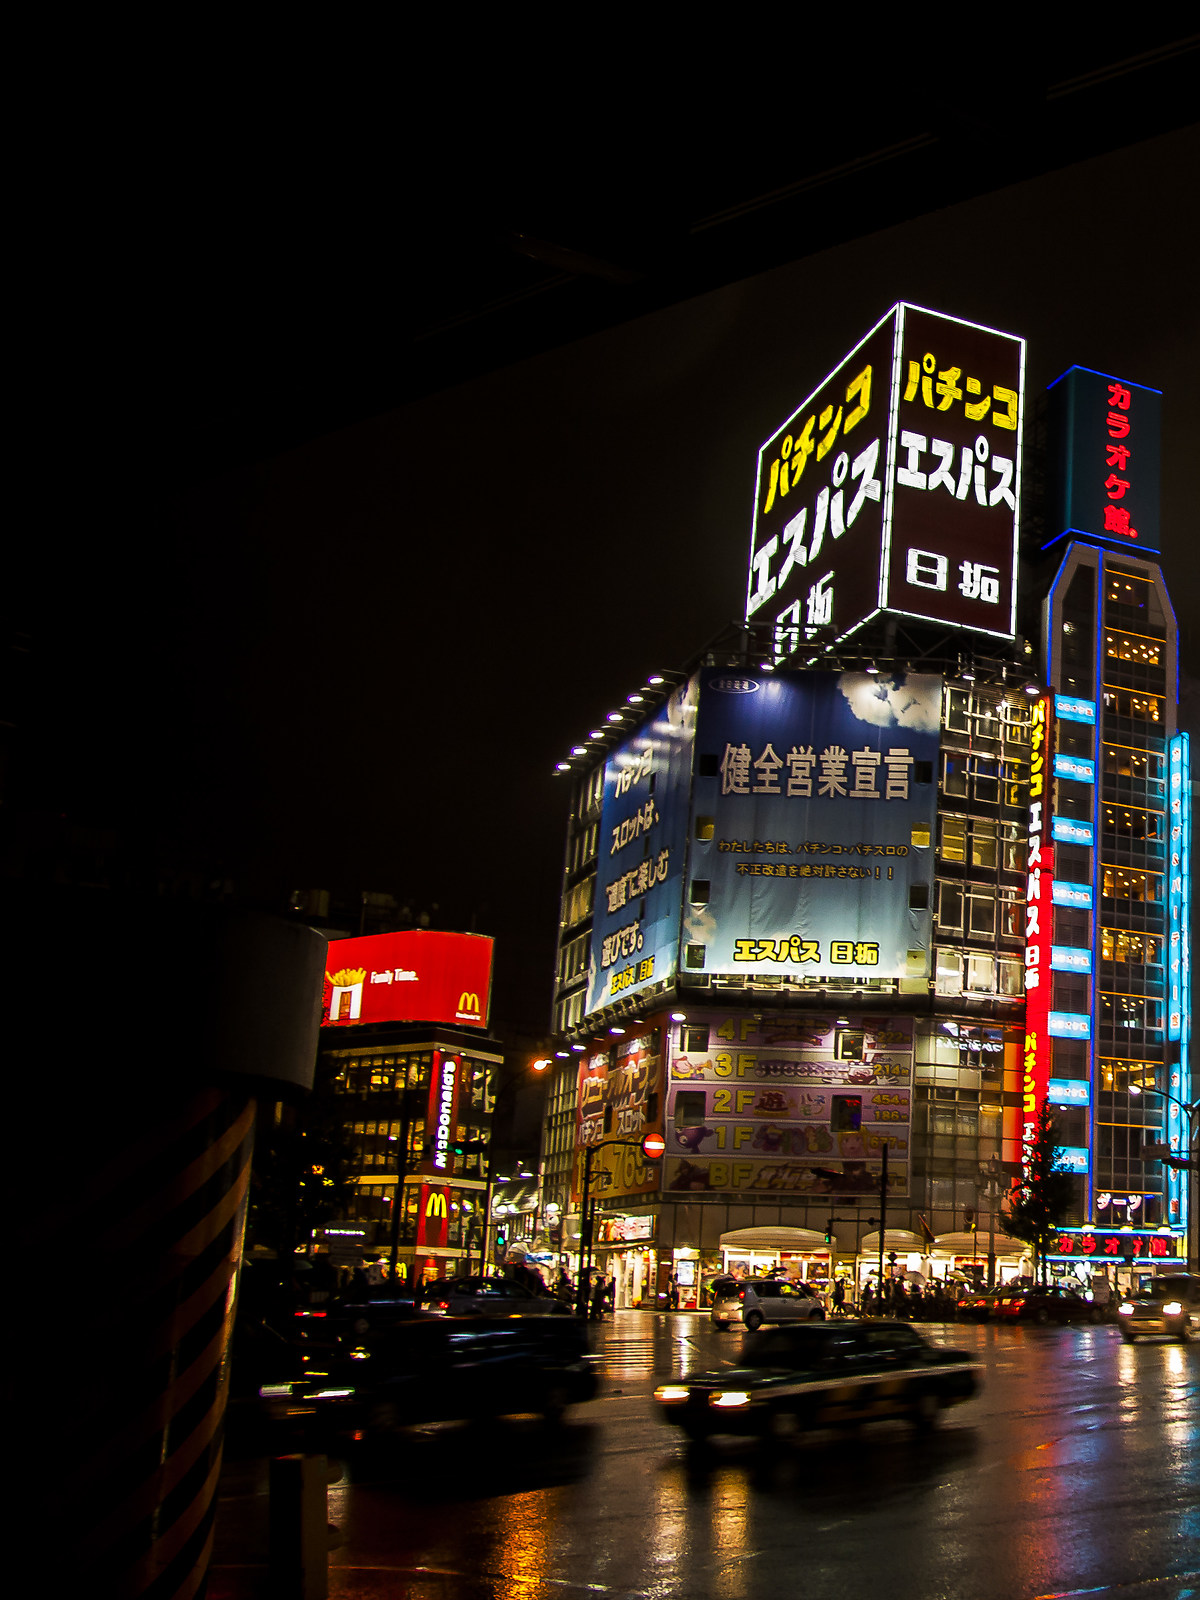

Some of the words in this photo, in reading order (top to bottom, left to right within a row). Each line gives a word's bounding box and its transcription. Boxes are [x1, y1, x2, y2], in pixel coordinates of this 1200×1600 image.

[903, 352, 1018, 431] パチンコ
[764, 365, 872, 514] パチンコ
[897, 430, 1016, 511] エスパス
[747, 438, 882, 616] エスパス
[1029, 699, 1046, 797] パチンコ
[720, 742, 915, 801] 健全営業宣言
[718, 840, 909, 858] わたしたちは、パチンコ・パチスロの
[606, 848, 670, 914] 適度に楽しむ
[737, 862, 894, 880] 不正改造を絶対許さない！！
[1027, 801, 1043, 938] エスパス
[733, 934, 821, 964] エスパス
[610, 963, 635, 996] エスパス
[717, 1018, 759, 1042] 4F
[714, 1053, 758, 1077] 3F
[1022, 1035, 1037, 1112] パチンコ
[713, 1089, 756, 1114] 2F
[617, 1107, 647, 1135] スロット
[714, 1126, 753, 1150] 1F
[708, 1162, 753, 1188] BF
[1097, 1193, 1142, 1210] ダーツ
